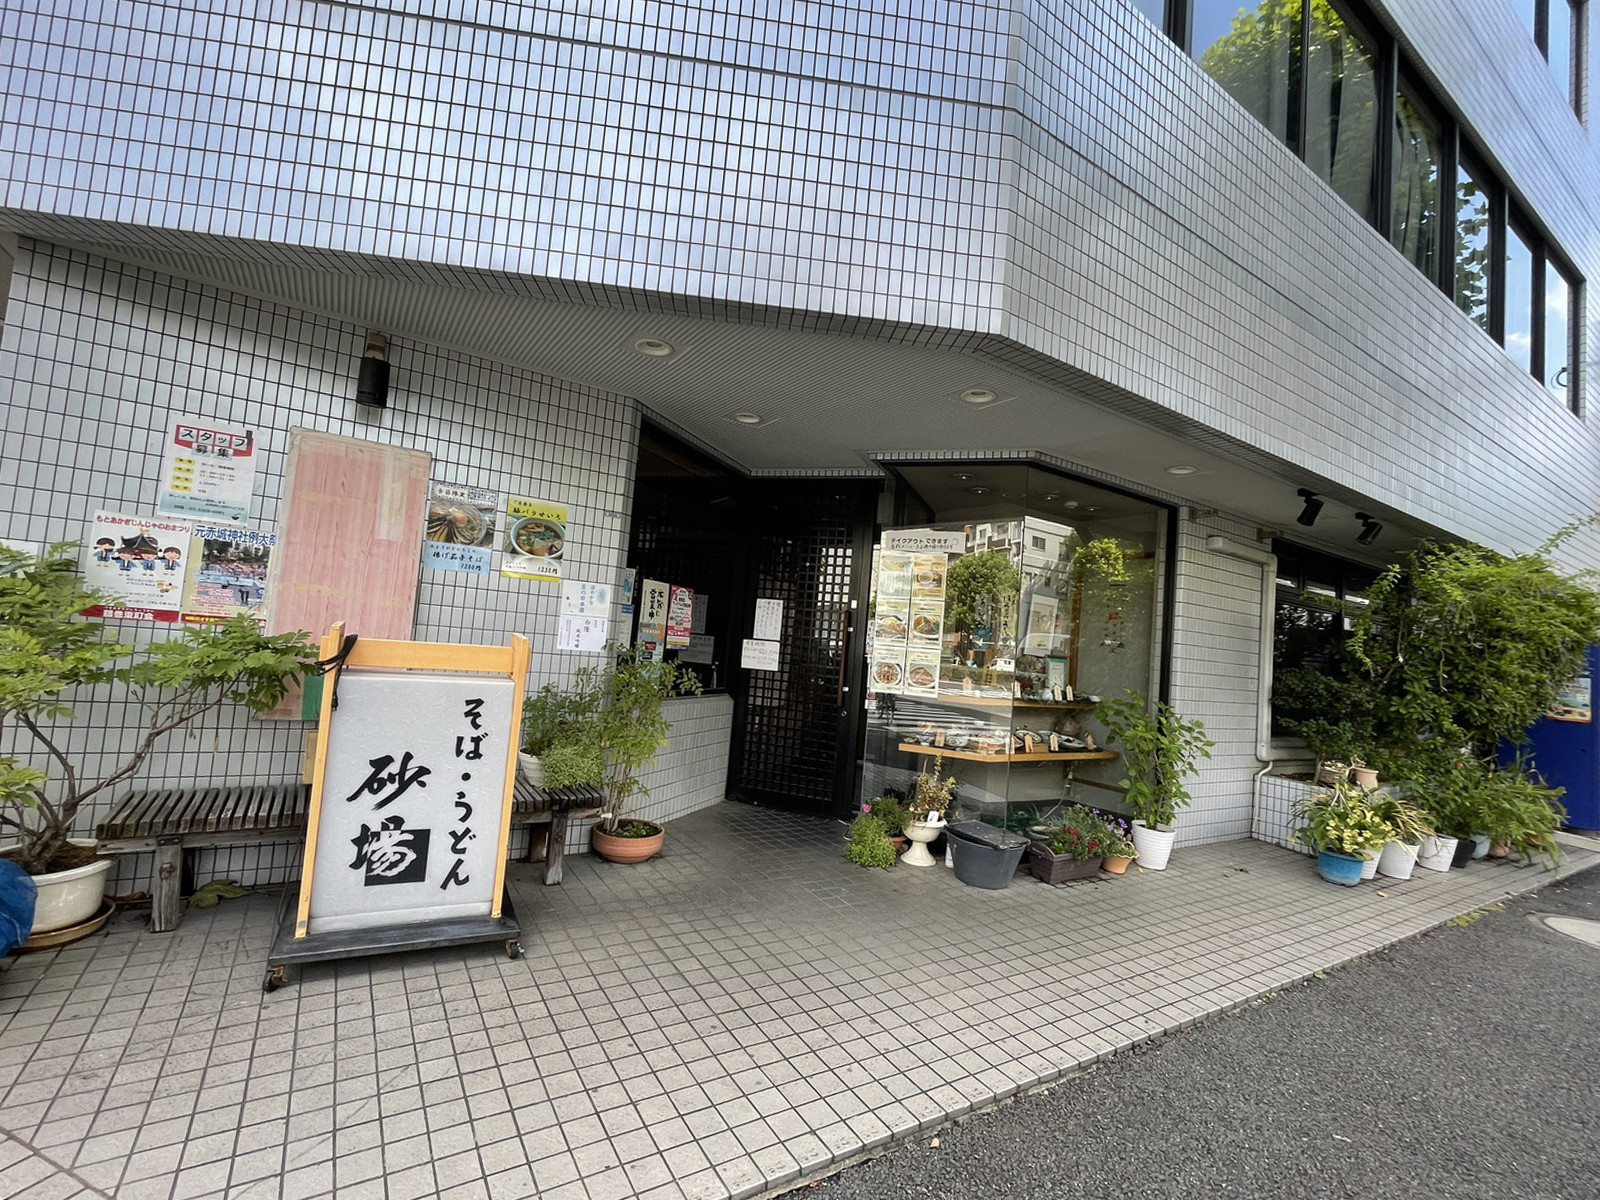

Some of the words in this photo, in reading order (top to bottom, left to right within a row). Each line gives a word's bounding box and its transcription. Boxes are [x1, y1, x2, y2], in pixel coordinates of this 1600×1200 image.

[181, 428, 246, 447] スタッフ
[196, 444, 230, 458] 募集
[96, 514, 191, 533] もとあかぎじんじゃのおまつり
[440, 697, 489, 890] そば・うどん
[346, 751, 432, 878] 砂場
